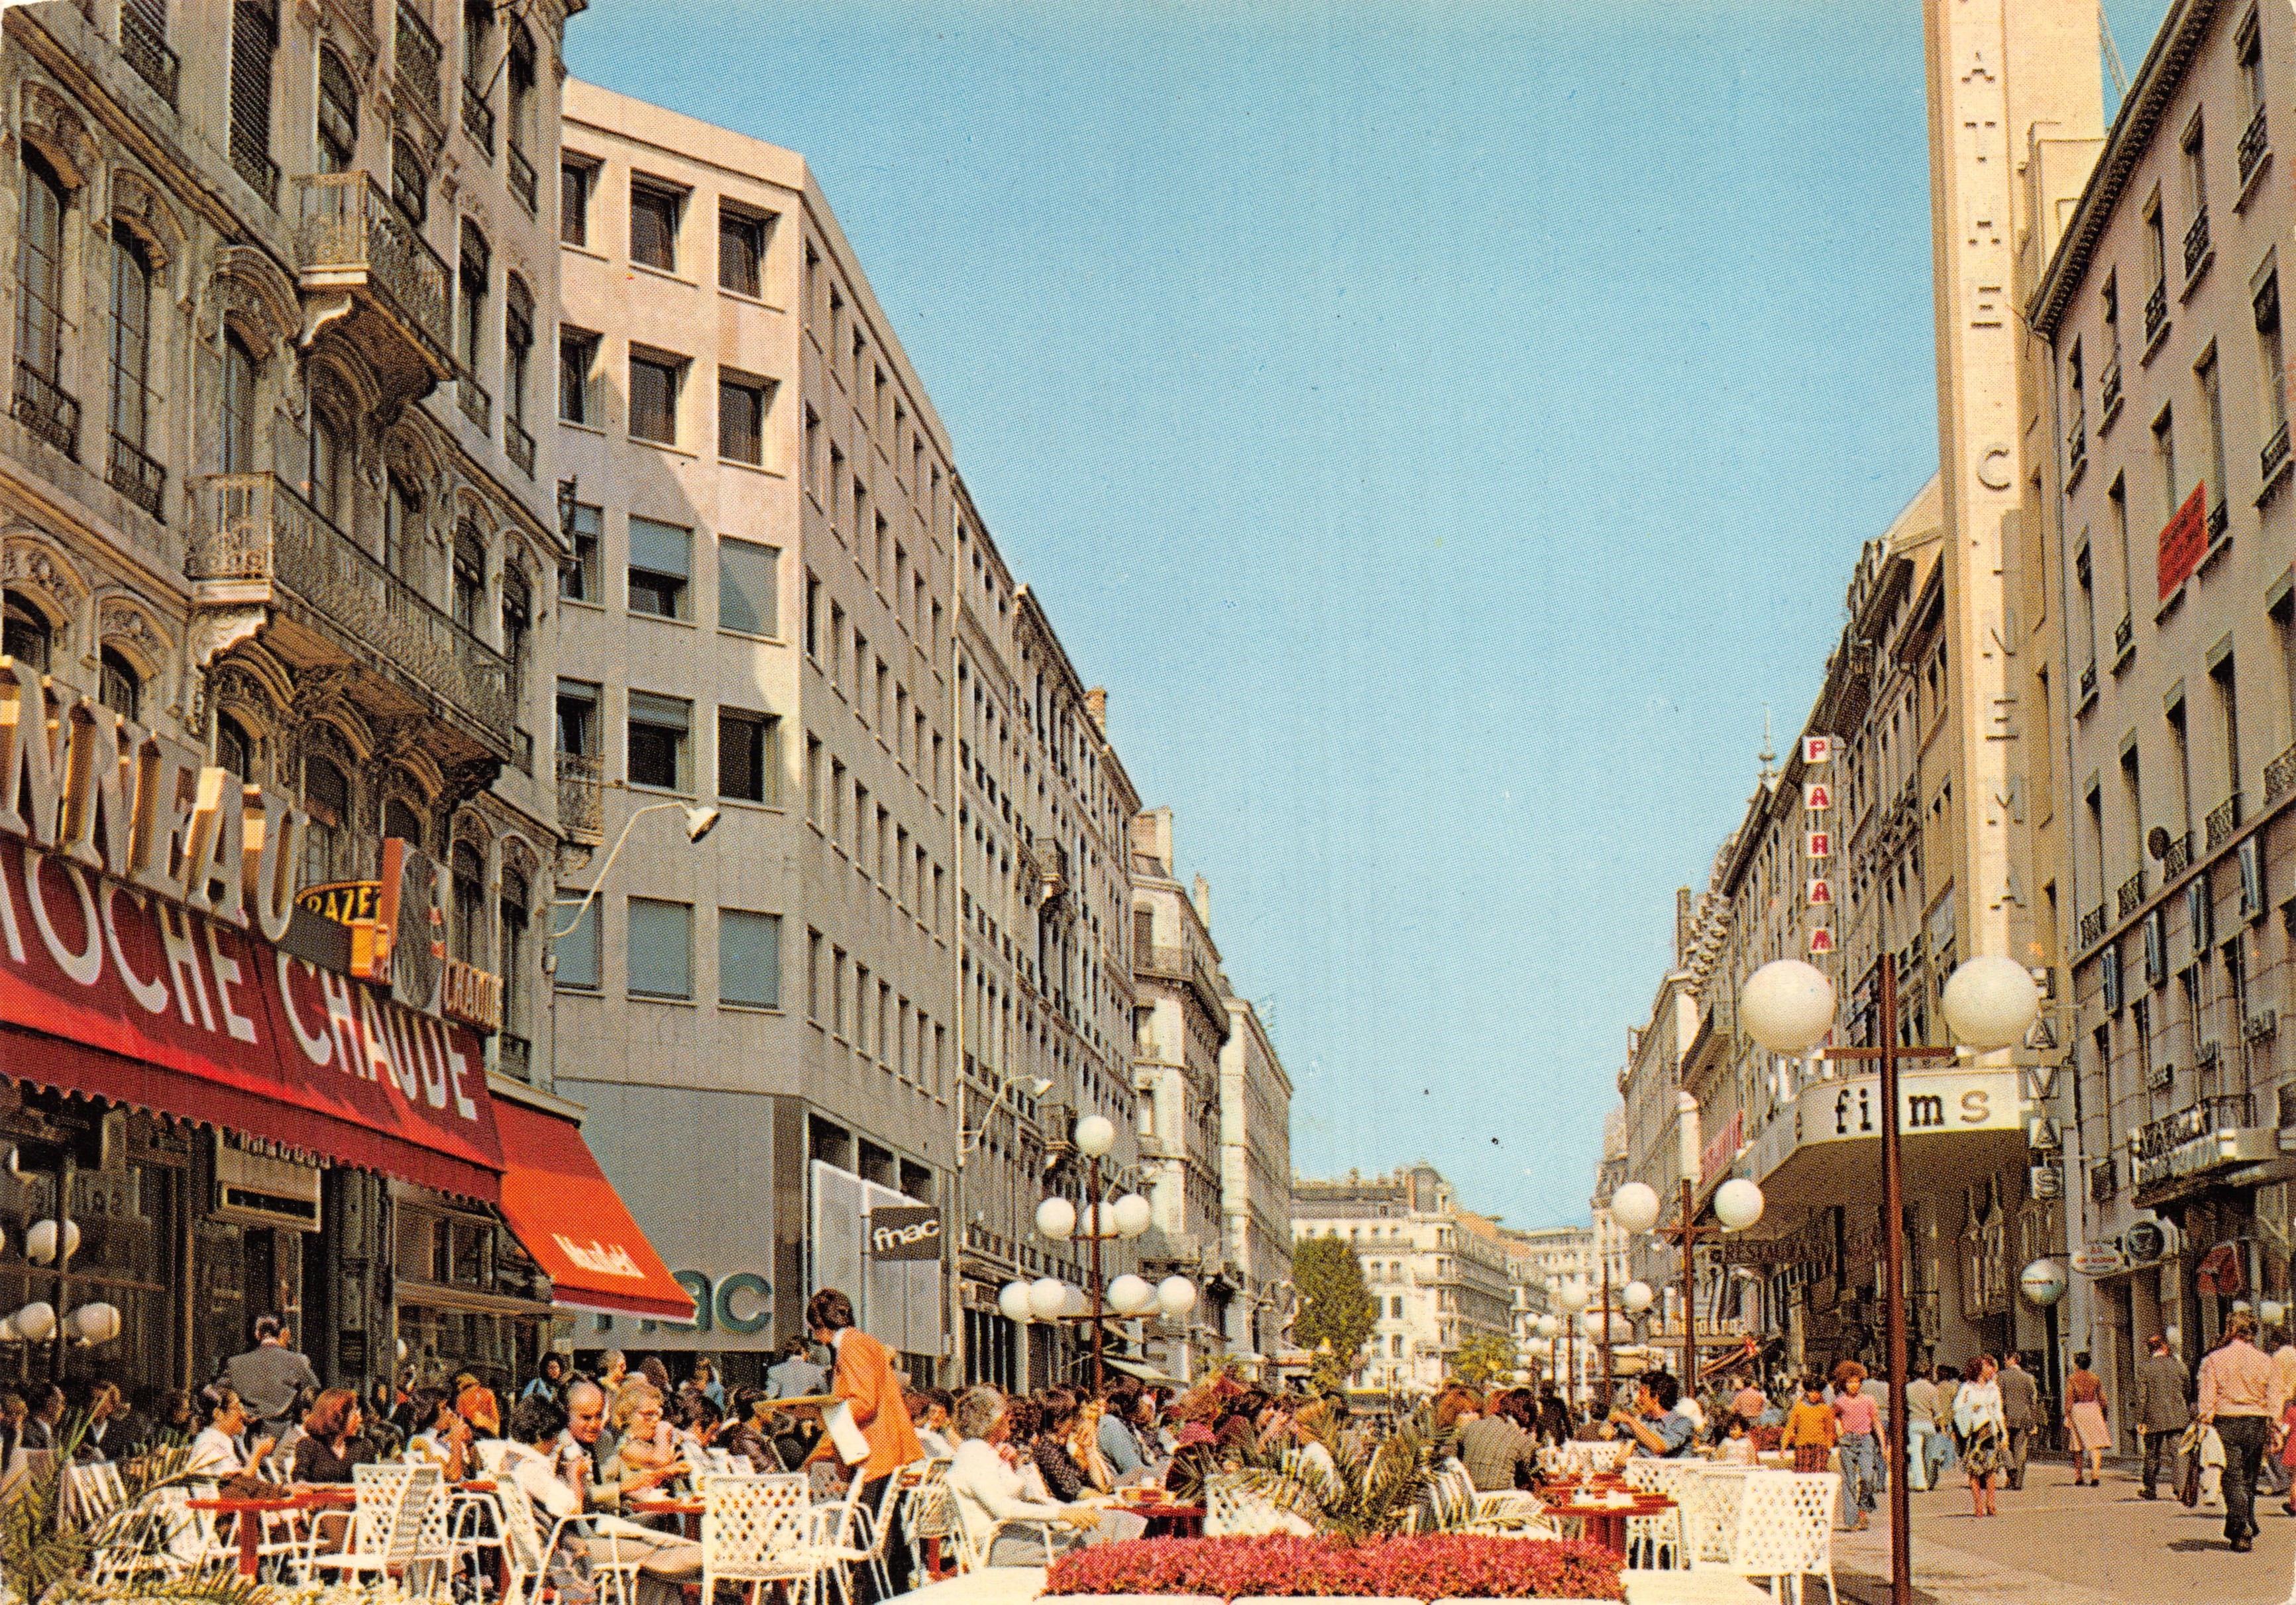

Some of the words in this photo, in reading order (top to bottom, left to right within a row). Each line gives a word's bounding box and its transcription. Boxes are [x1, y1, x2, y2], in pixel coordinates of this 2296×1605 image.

[277, 950, 478, 1122] CHAUDE
[1833, 1087, 1991, 1135] fims
[873, 1219, 940, 1252] fnac
